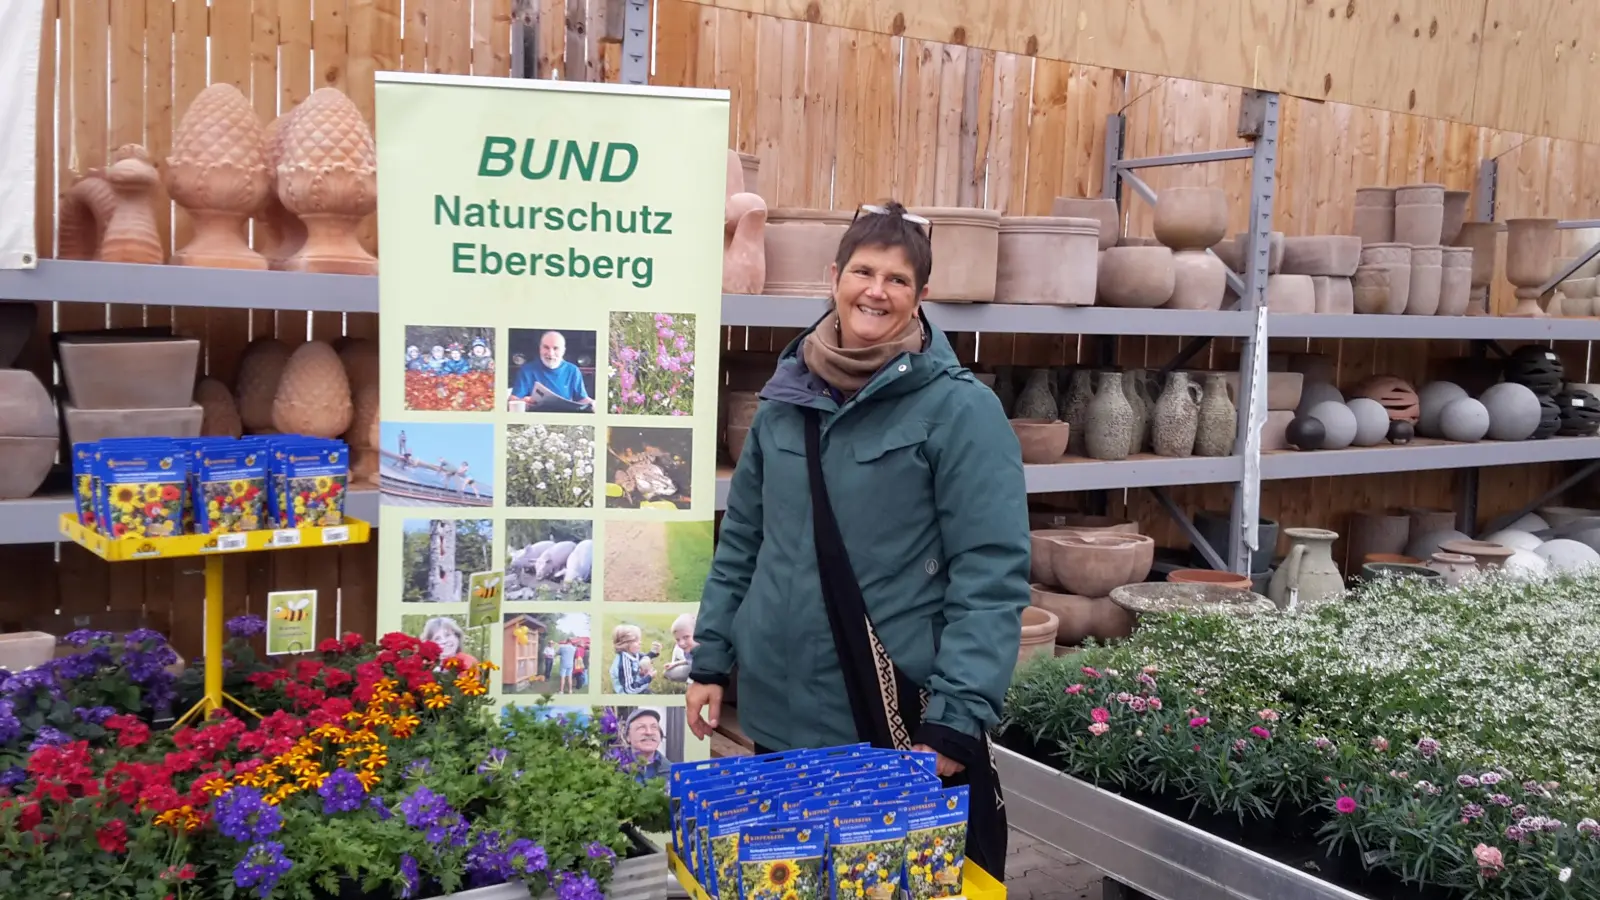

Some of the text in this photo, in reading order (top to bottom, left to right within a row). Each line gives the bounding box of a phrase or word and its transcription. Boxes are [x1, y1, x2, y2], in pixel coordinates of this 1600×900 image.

[478, 136, 638, 182] BUND
[434, 195, 673, 234] Naturschutz
[453, 243, 653, 288] Ebersberg
